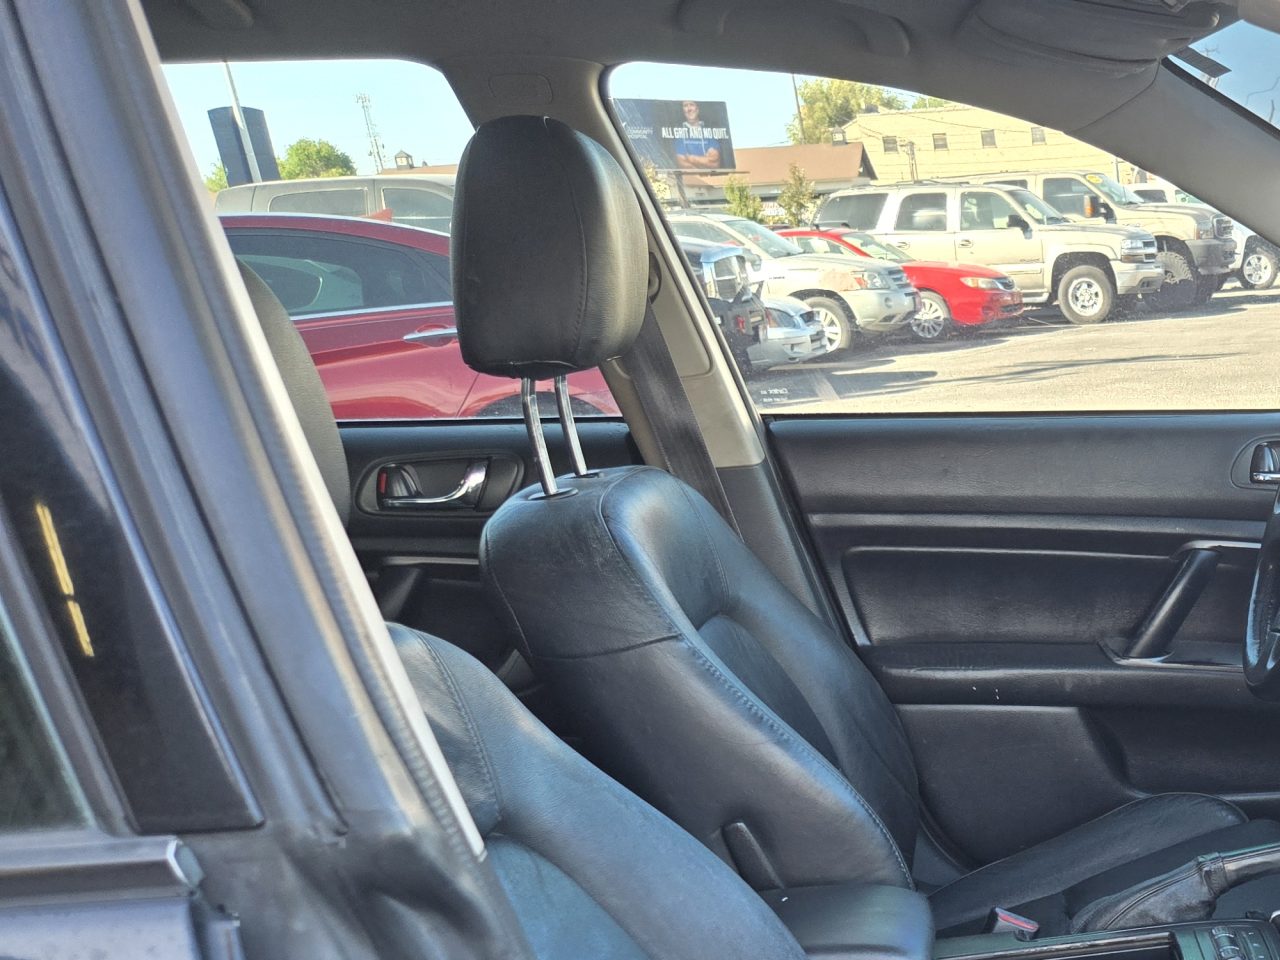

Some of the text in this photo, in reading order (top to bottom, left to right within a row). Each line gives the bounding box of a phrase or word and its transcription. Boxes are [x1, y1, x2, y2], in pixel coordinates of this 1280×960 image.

[662, 127, 674, 139] ALL
[674, 127, 689, 139] GRIT
[690, 127, 702, 139] AND
[703, 128, 712, 139] NO
